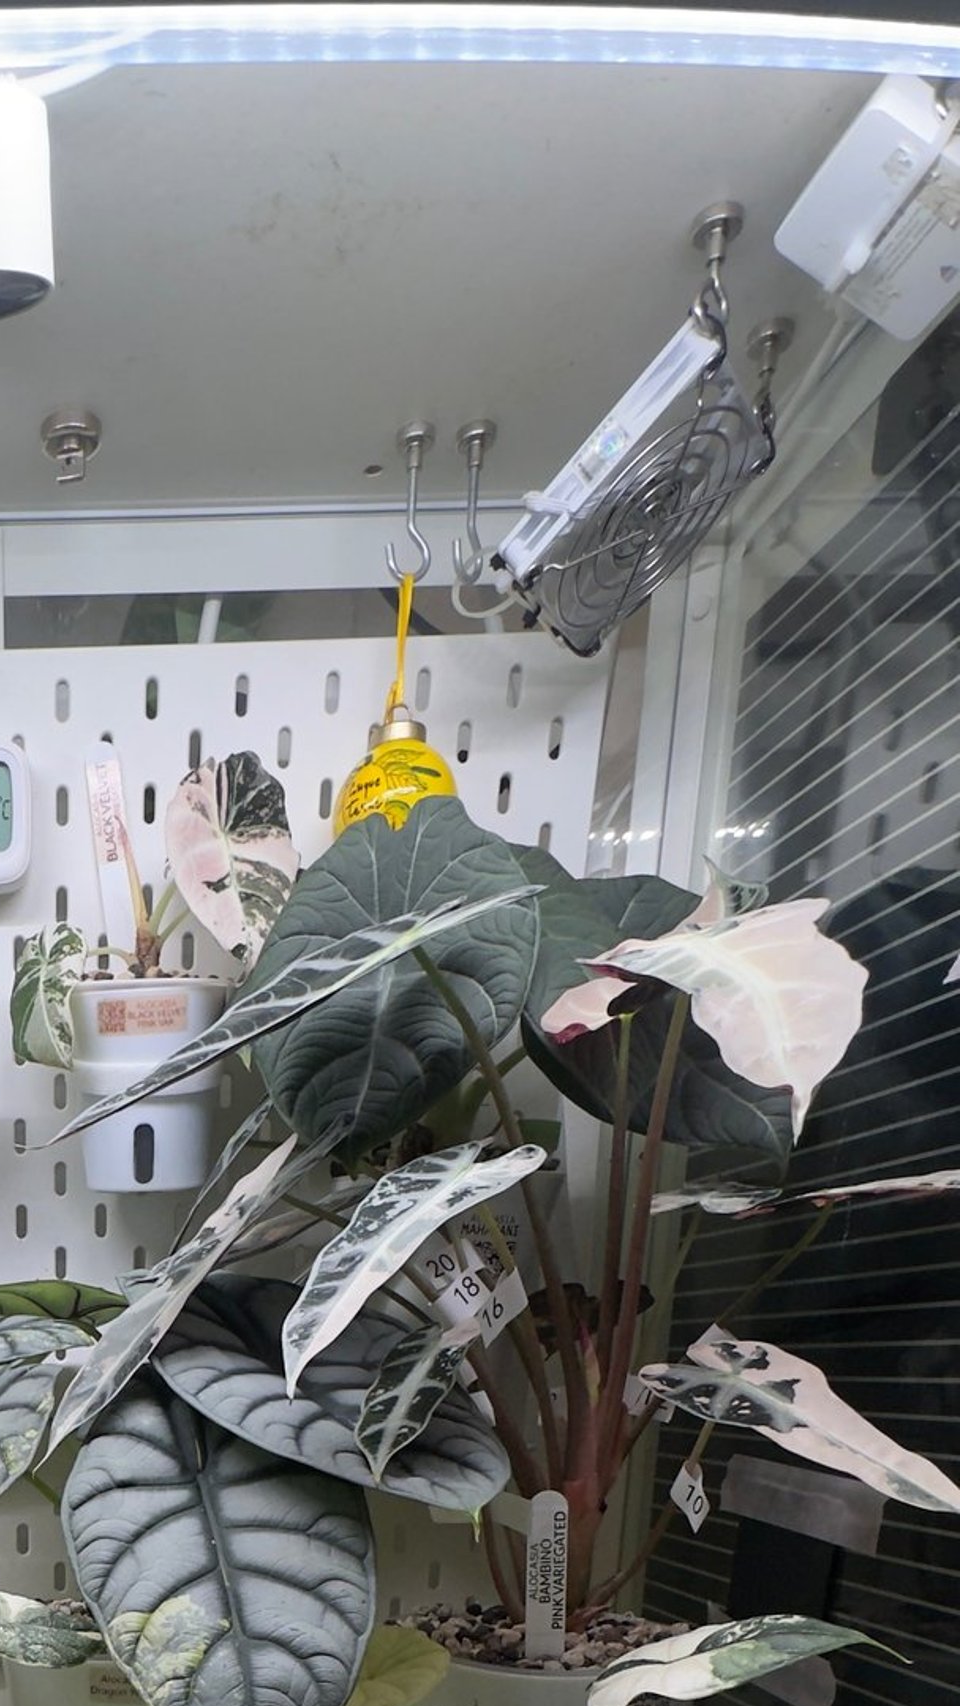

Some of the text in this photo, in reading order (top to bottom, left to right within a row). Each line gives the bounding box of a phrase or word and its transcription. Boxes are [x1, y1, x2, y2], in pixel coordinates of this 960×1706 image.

[102, 814, 119, 863] BLACK
[426, 1254, 455, 1279] 20
[453, 1276, 480, 1305] 18
[482, 1297, 504, 1328] 16
[686, 1484, 703, 1514] 10
[528, 1543, 539, 1600] ALOCASIA
[539, 1538, 553, 1604] BAMBINO
[551, 1510, 566, 1630] PINK VARIEGATED
